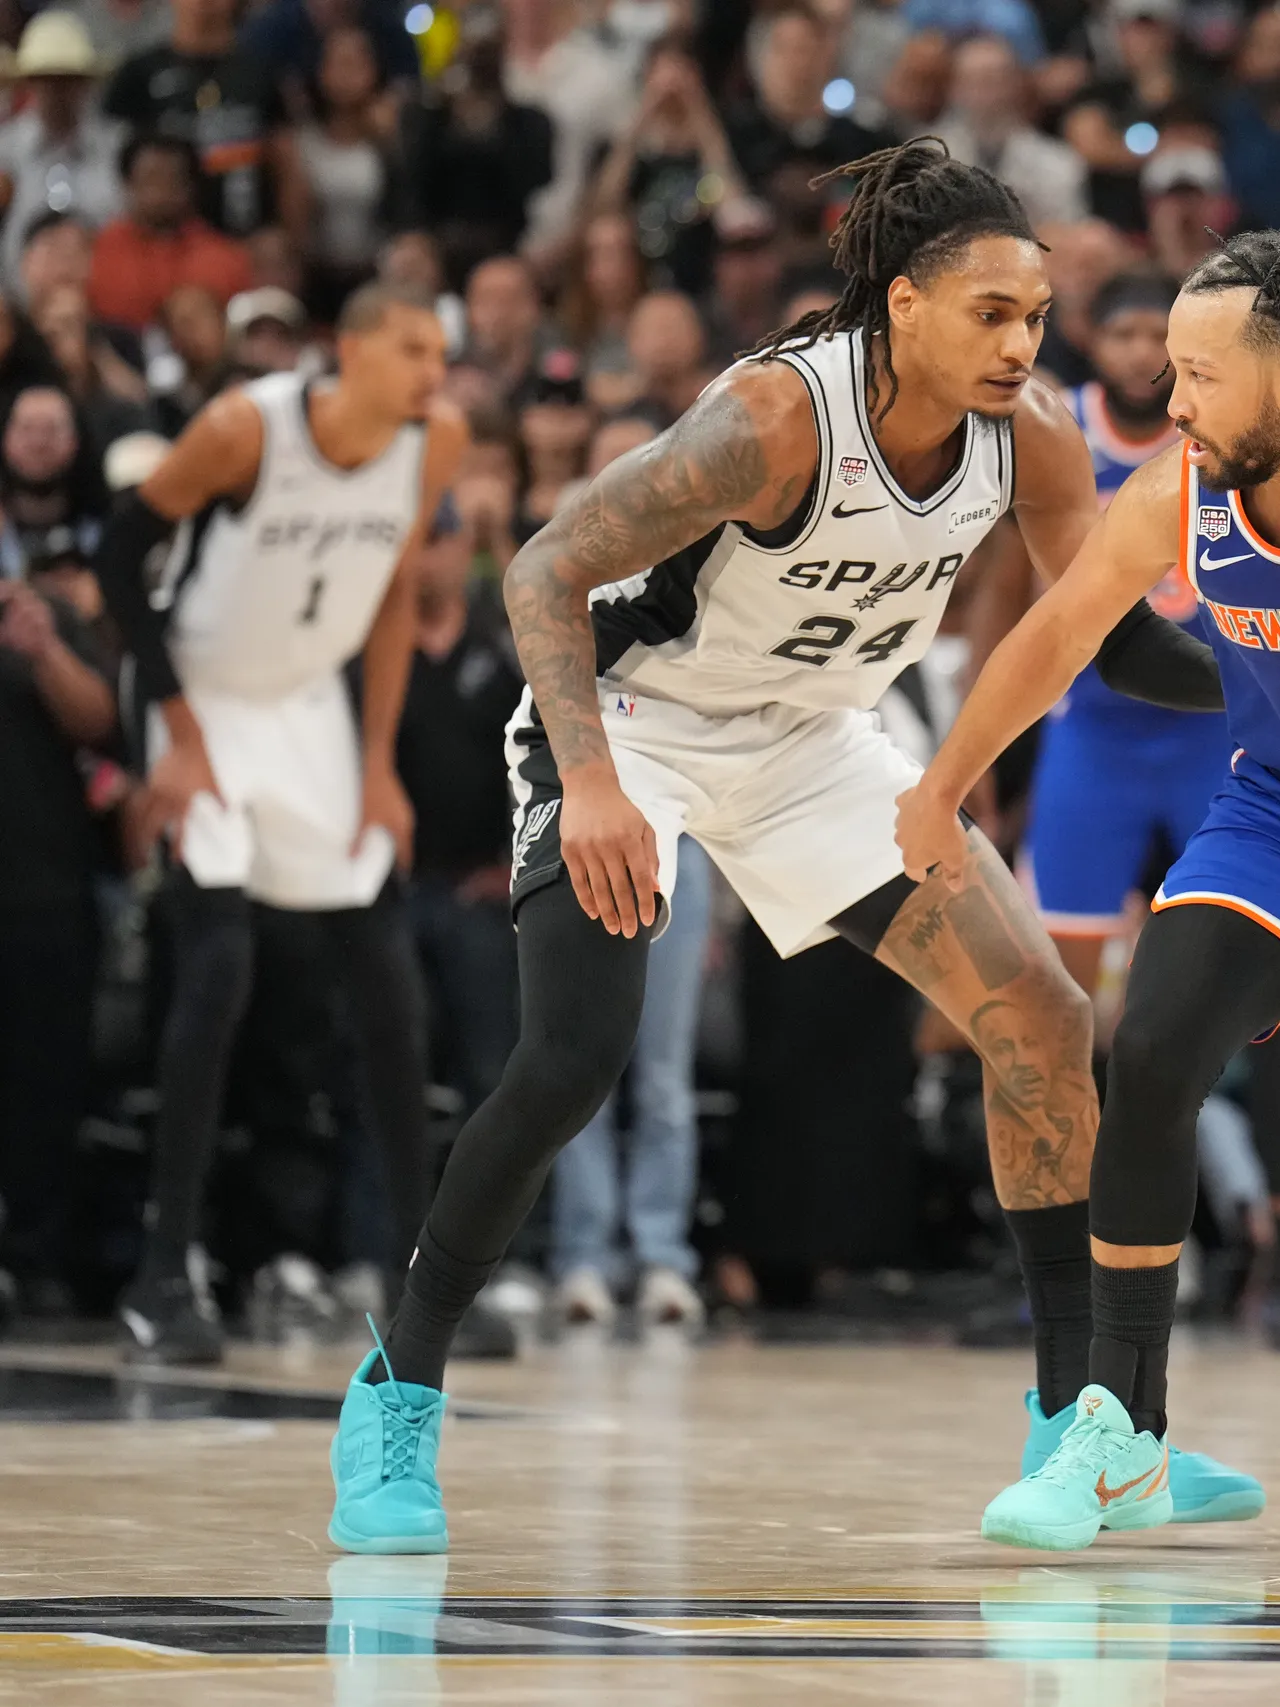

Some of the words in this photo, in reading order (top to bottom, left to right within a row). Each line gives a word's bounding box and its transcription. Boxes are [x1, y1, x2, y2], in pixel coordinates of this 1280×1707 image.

[842, 459, 866, 468] USA
[837, 471, 866, 483] 250
[954, 507, 991, 527] LEDGER
[1201, 510, 1227, 520] USA
[1200, 523, 1228, 533] 250
[778, 552, 964, 612] SPUR
[298, 575, 324, 624] 1
[764, 612, 926, 670] 24
